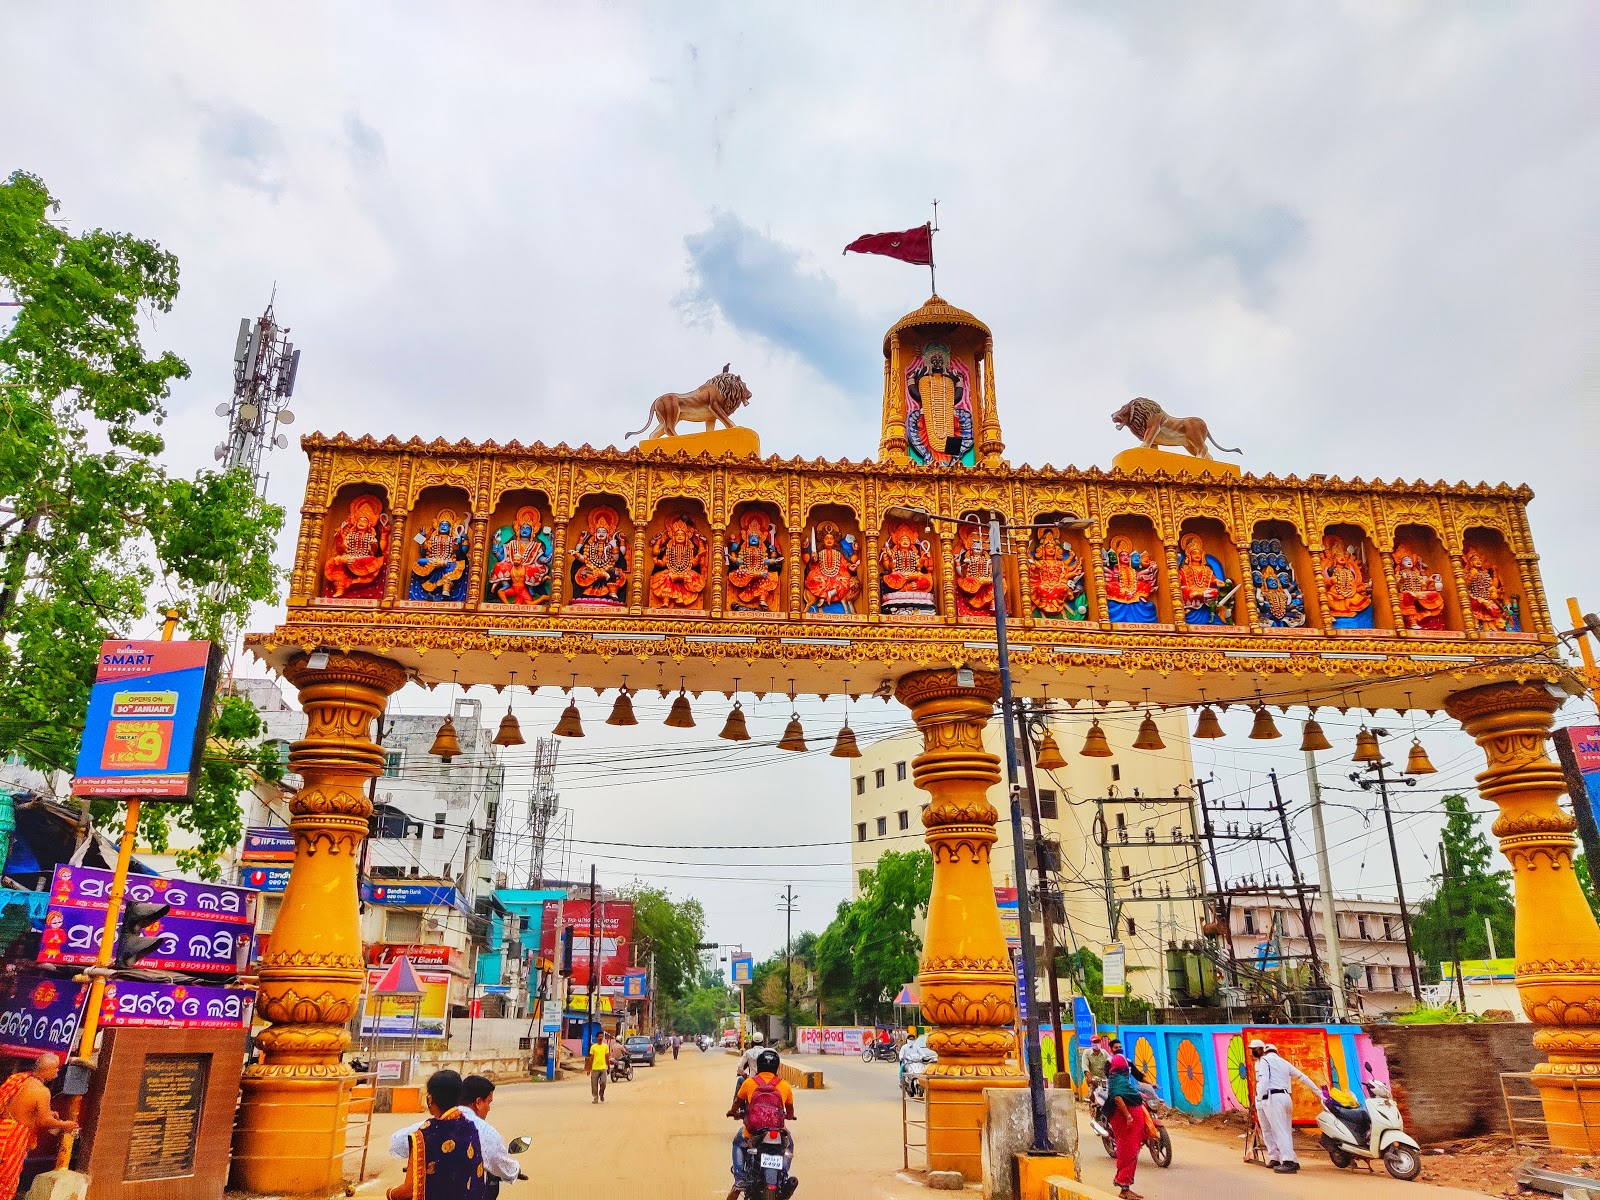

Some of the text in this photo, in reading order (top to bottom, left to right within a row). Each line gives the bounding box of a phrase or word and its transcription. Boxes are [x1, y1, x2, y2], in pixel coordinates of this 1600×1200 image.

[103, 655, 154, 664] SMART
[133, 705, 170, 713] JANUARY
[115, 722, 160, 732] SUGAR
[1578, 742, 1600, 753] SM
[418, 956, 443, 964] Bank
